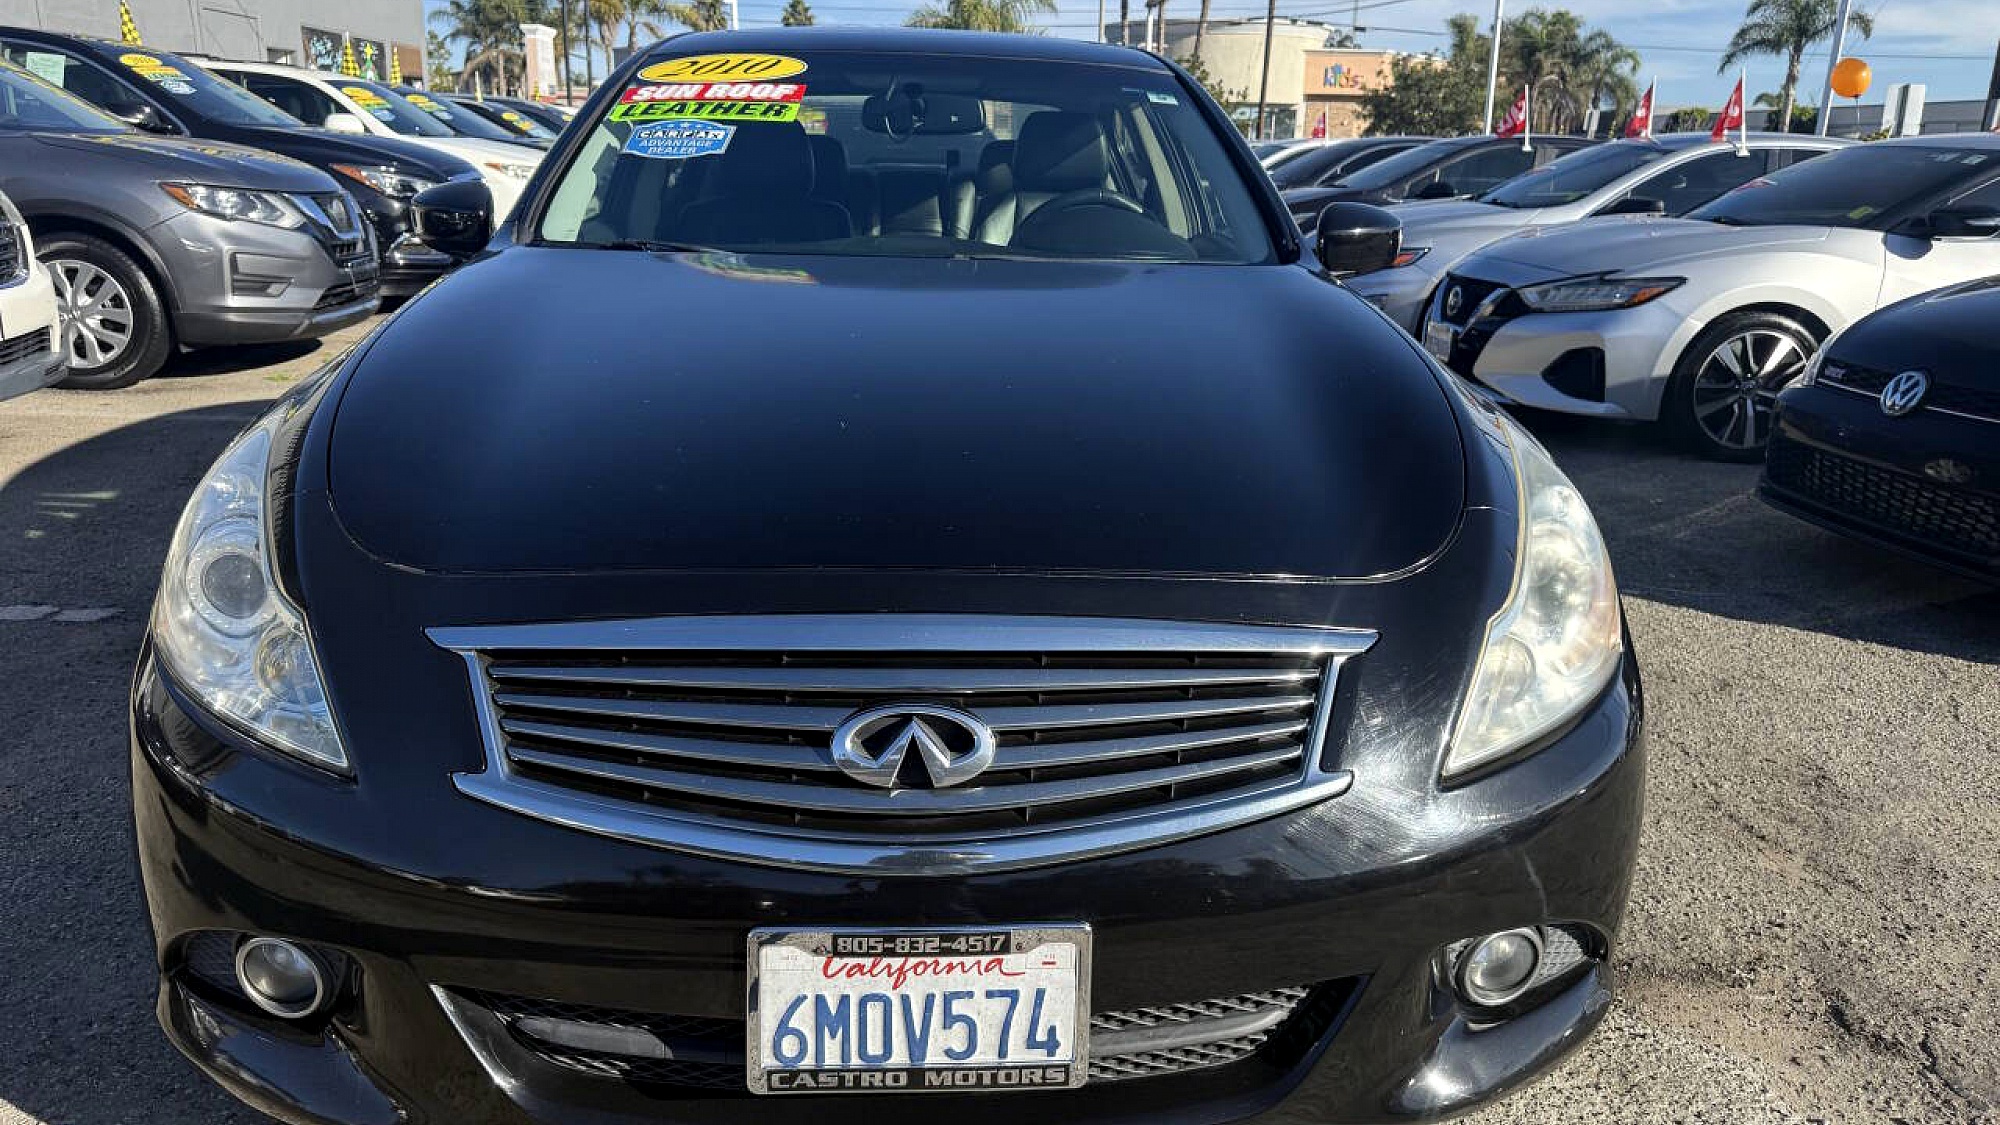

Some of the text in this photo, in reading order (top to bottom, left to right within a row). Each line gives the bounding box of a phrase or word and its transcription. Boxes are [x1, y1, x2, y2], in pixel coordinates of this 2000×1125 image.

[656, 58, 782, 77] 2010
[631, 84, 799, 99] SUN ROOF
[620, 102, 790, 117] LEATHER
[637, 129, 726, 139] CARFAX
[638, 139, 713, 147] ADVANTAGE
[648, 146, 698, 154] DEALER
[837, 934, 1006, 954] 805-832-4517
[822, 955, 1026, 990] California
[772, 988, 1061, 1068] 6MOV574
[771, 1066, 1066, 1089] CASTRO MOTORS
